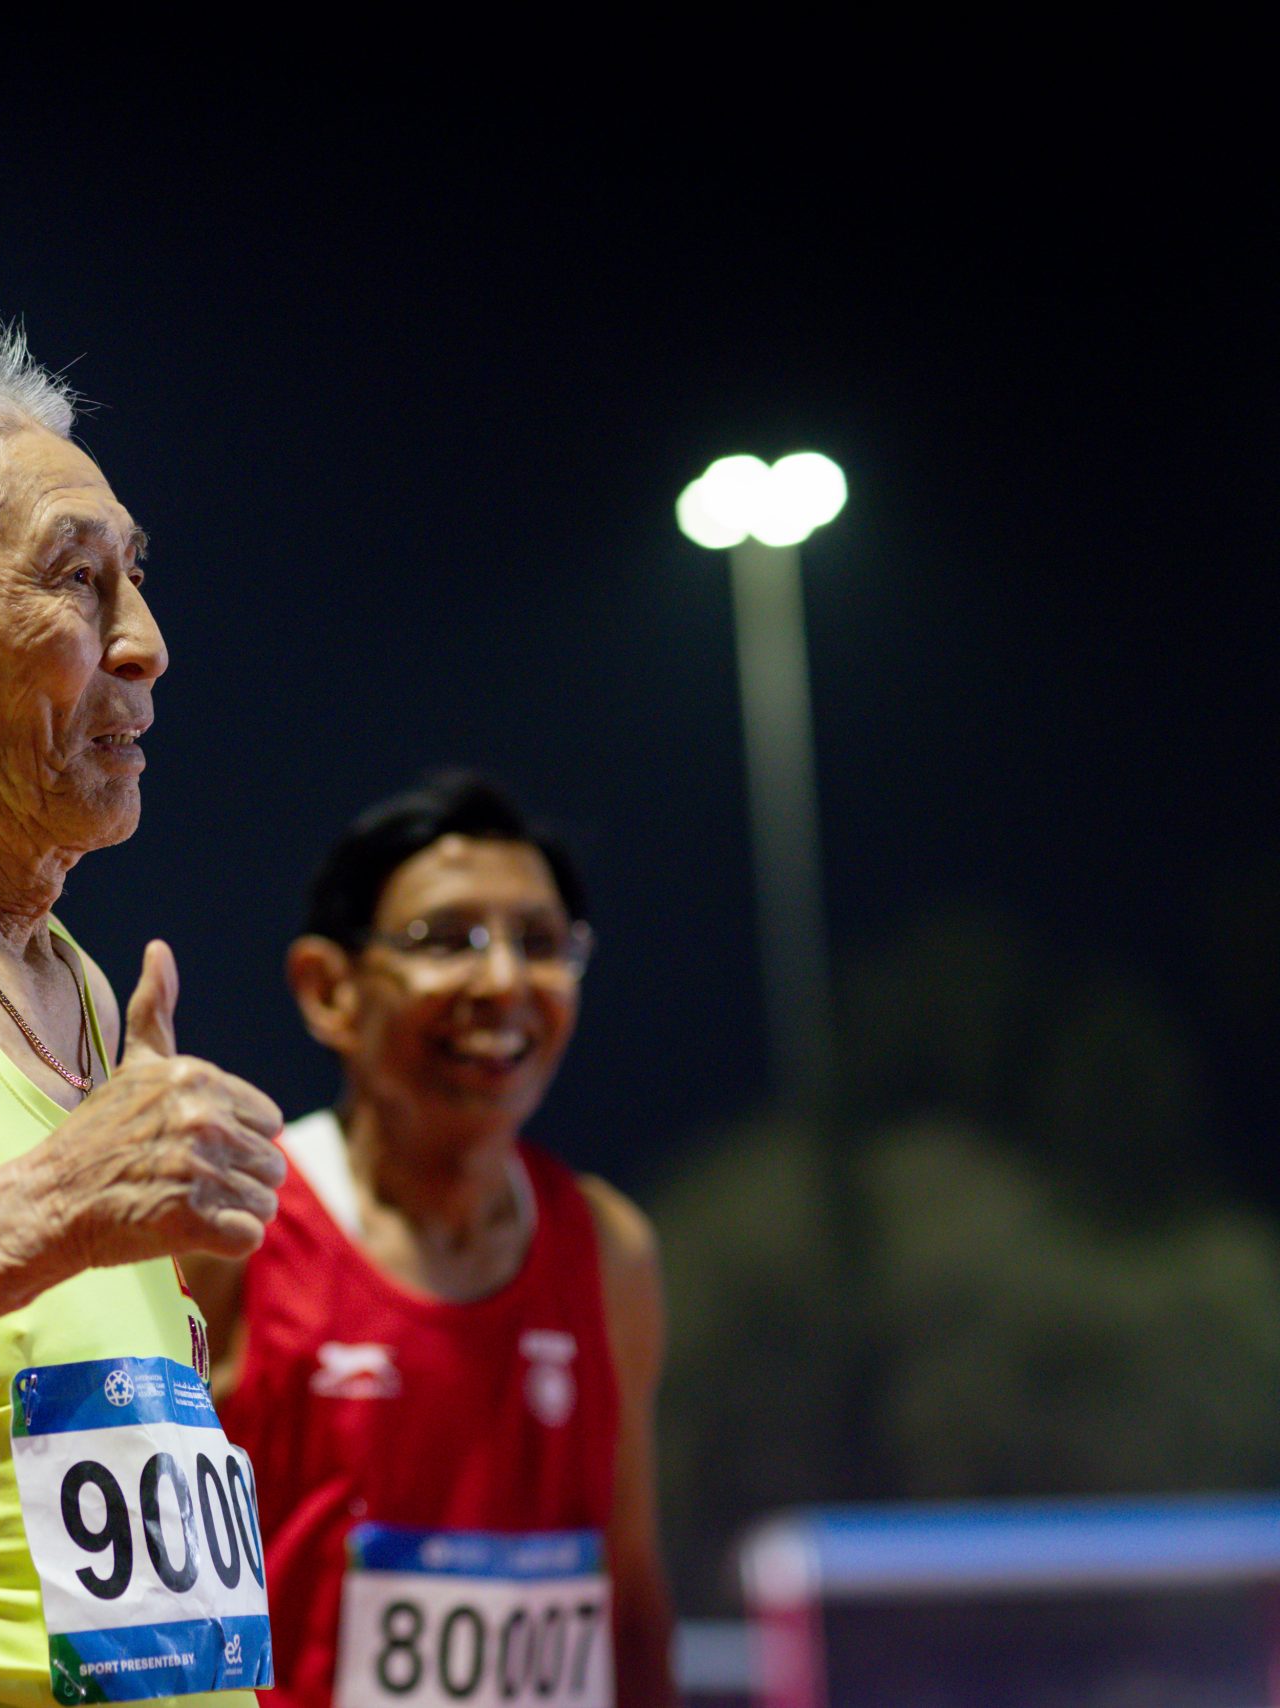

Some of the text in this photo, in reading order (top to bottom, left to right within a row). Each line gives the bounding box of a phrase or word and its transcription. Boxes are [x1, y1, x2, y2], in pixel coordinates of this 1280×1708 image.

[61, 1452, 264, 1600] 9000
[79, 1651, 195, 1676] SPORT PRESENTED BY
[376, 1600, 600, 1698] 80007
